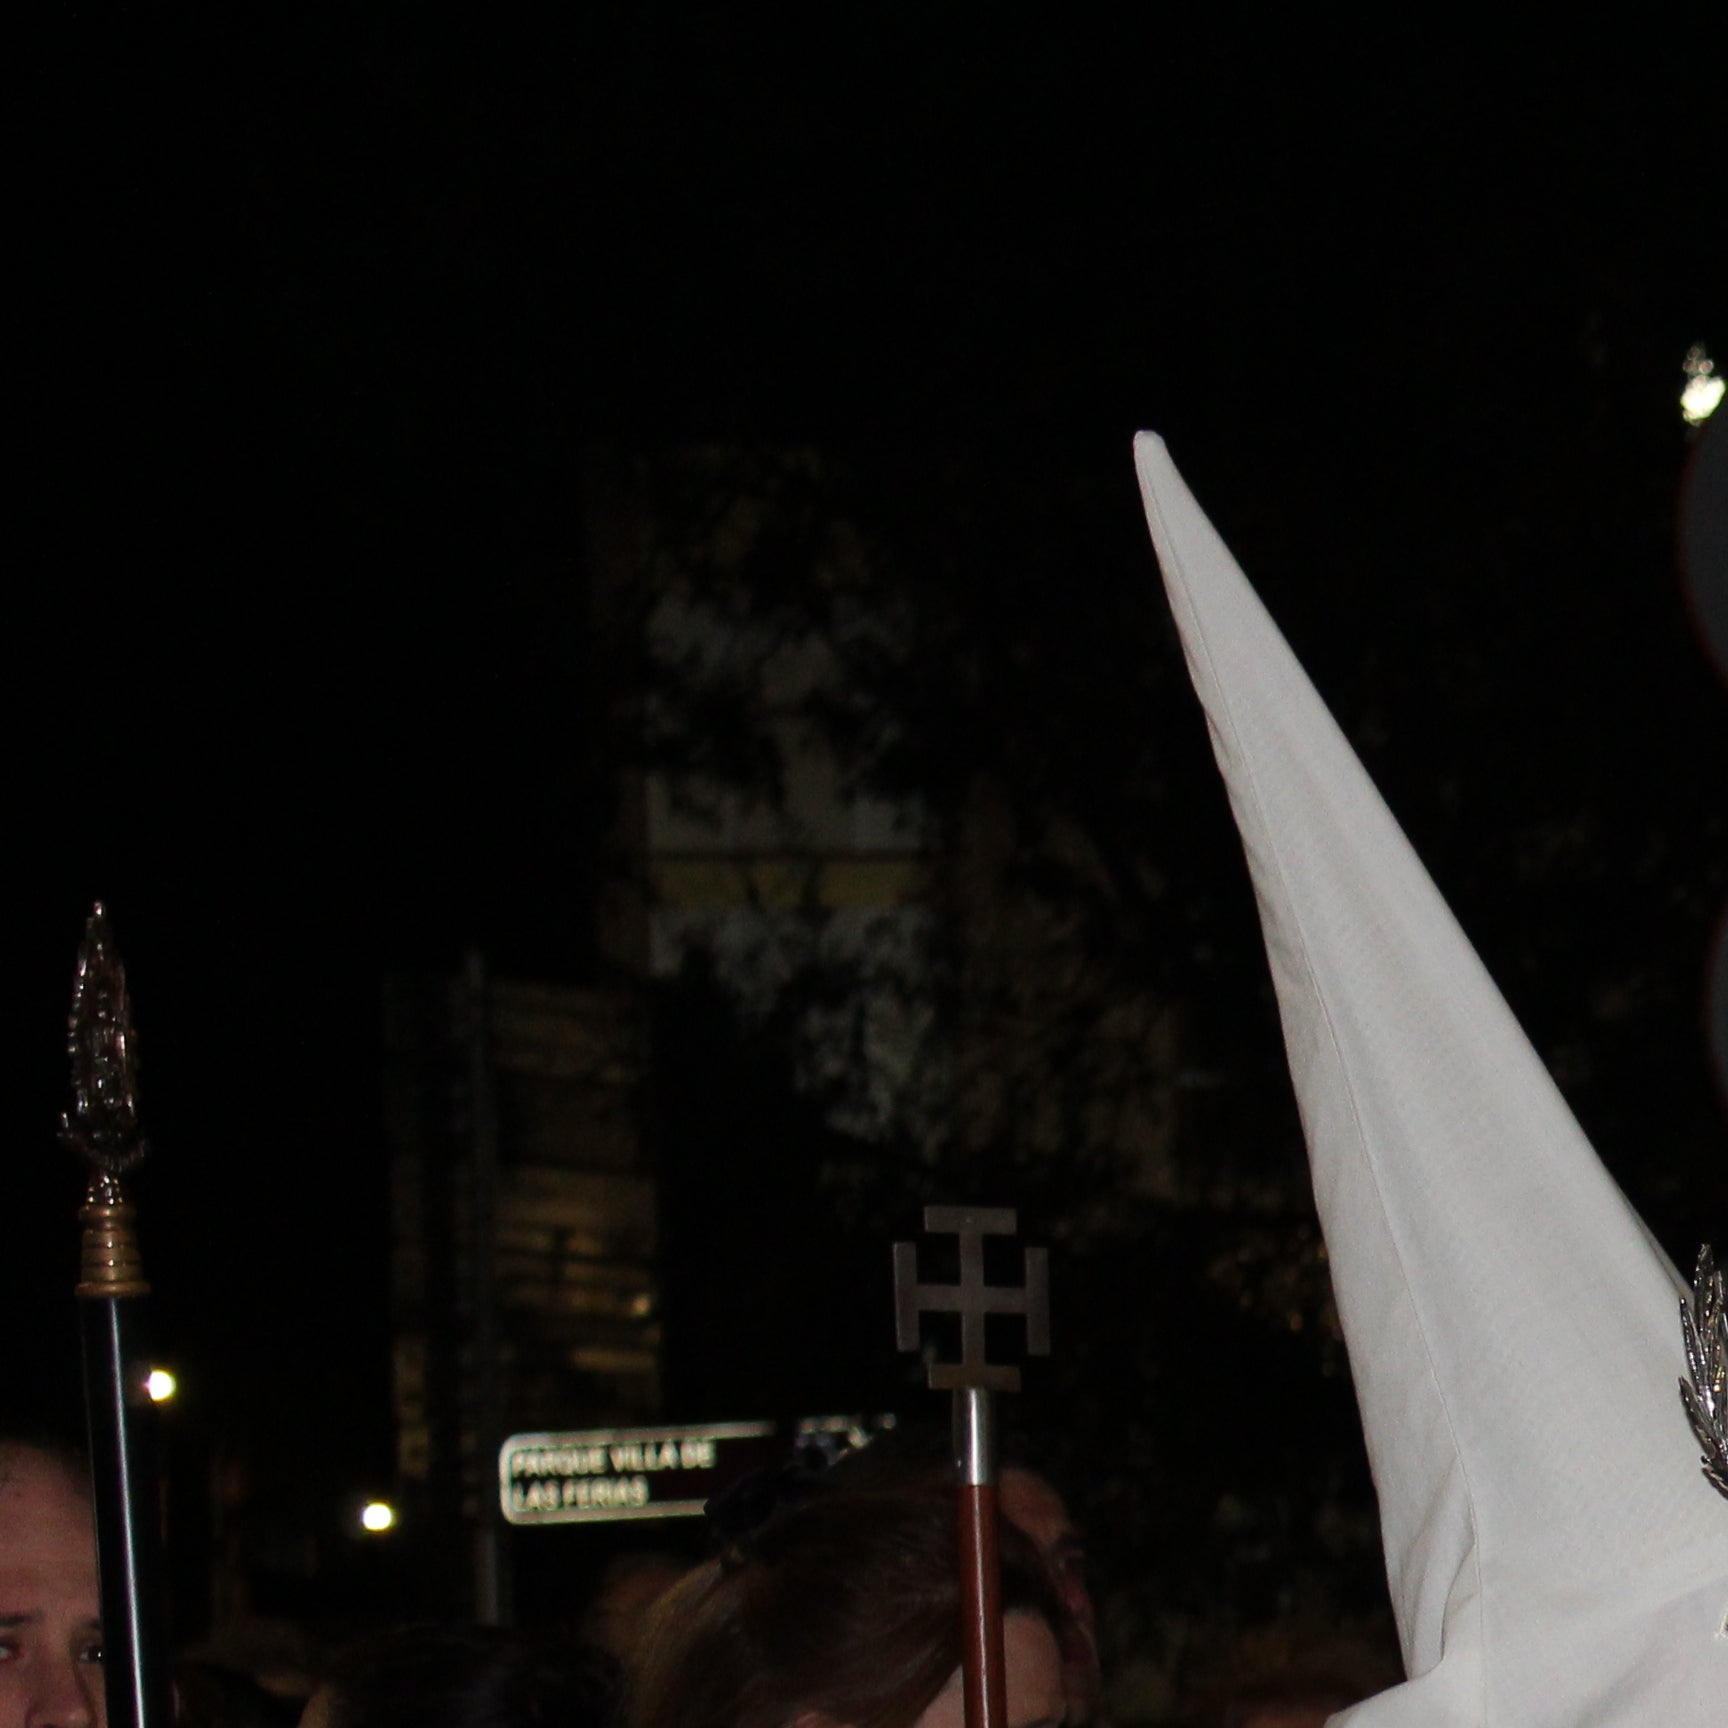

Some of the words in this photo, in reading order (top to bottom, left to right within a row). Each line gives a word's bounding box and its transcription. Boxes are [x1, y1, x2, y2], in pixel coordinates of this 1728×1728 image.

[511, 1448, 608, 1476] PARQUE
[609, 1441, 679, 1472] VILLA
[680, 1439, 717, 1470] DE
[512, 1480, 560, 1511] LAS
[562, 1475, 649, 1508] FERIAS
